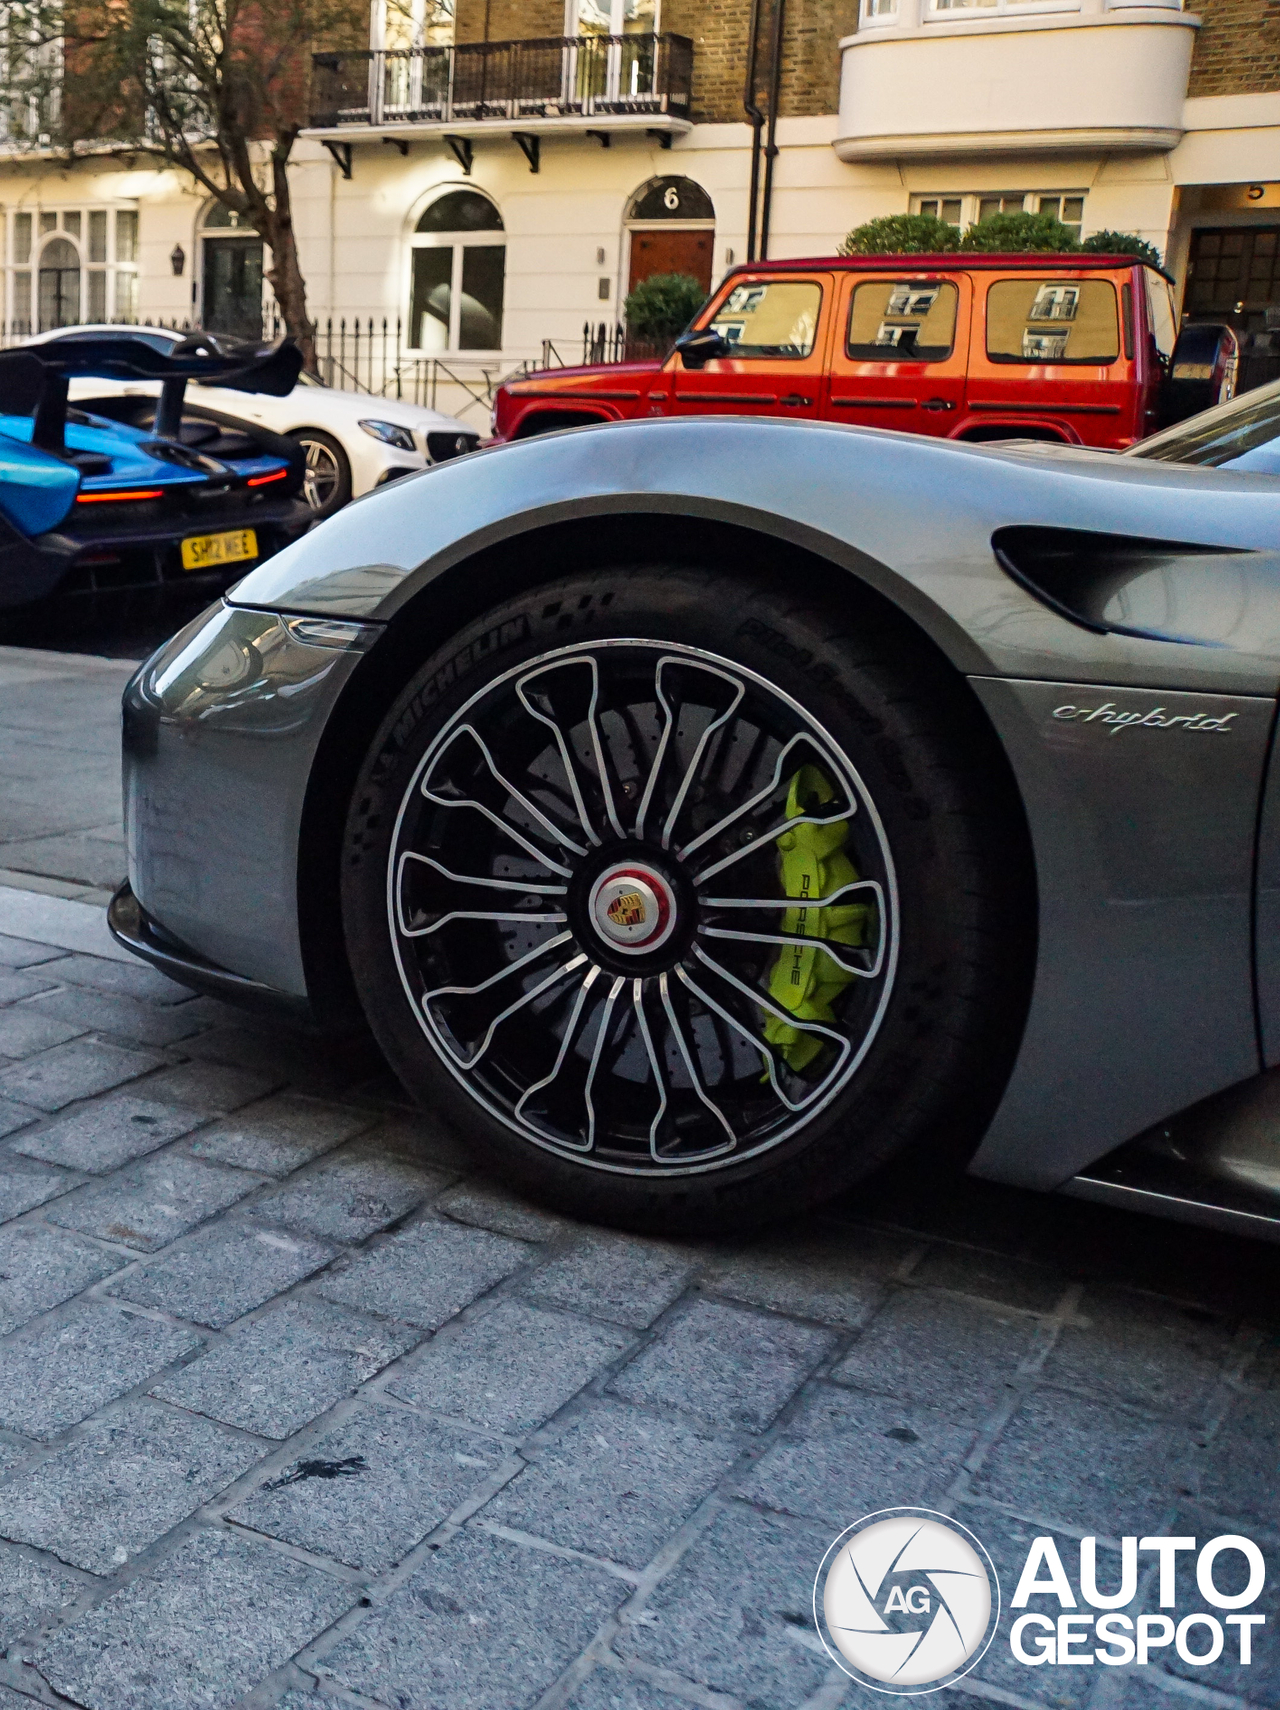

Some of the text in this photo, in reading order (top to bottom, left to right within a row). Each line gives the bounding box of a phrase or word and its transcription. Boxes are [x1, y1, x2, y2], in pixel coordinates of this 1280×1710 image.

[663, 187, 679, 210] 6
[736, 617, 813, 668] Pilot
[391, 615, 526, 748] MICHELIN
[1052, 703, 1240, 735] e-hybrid
